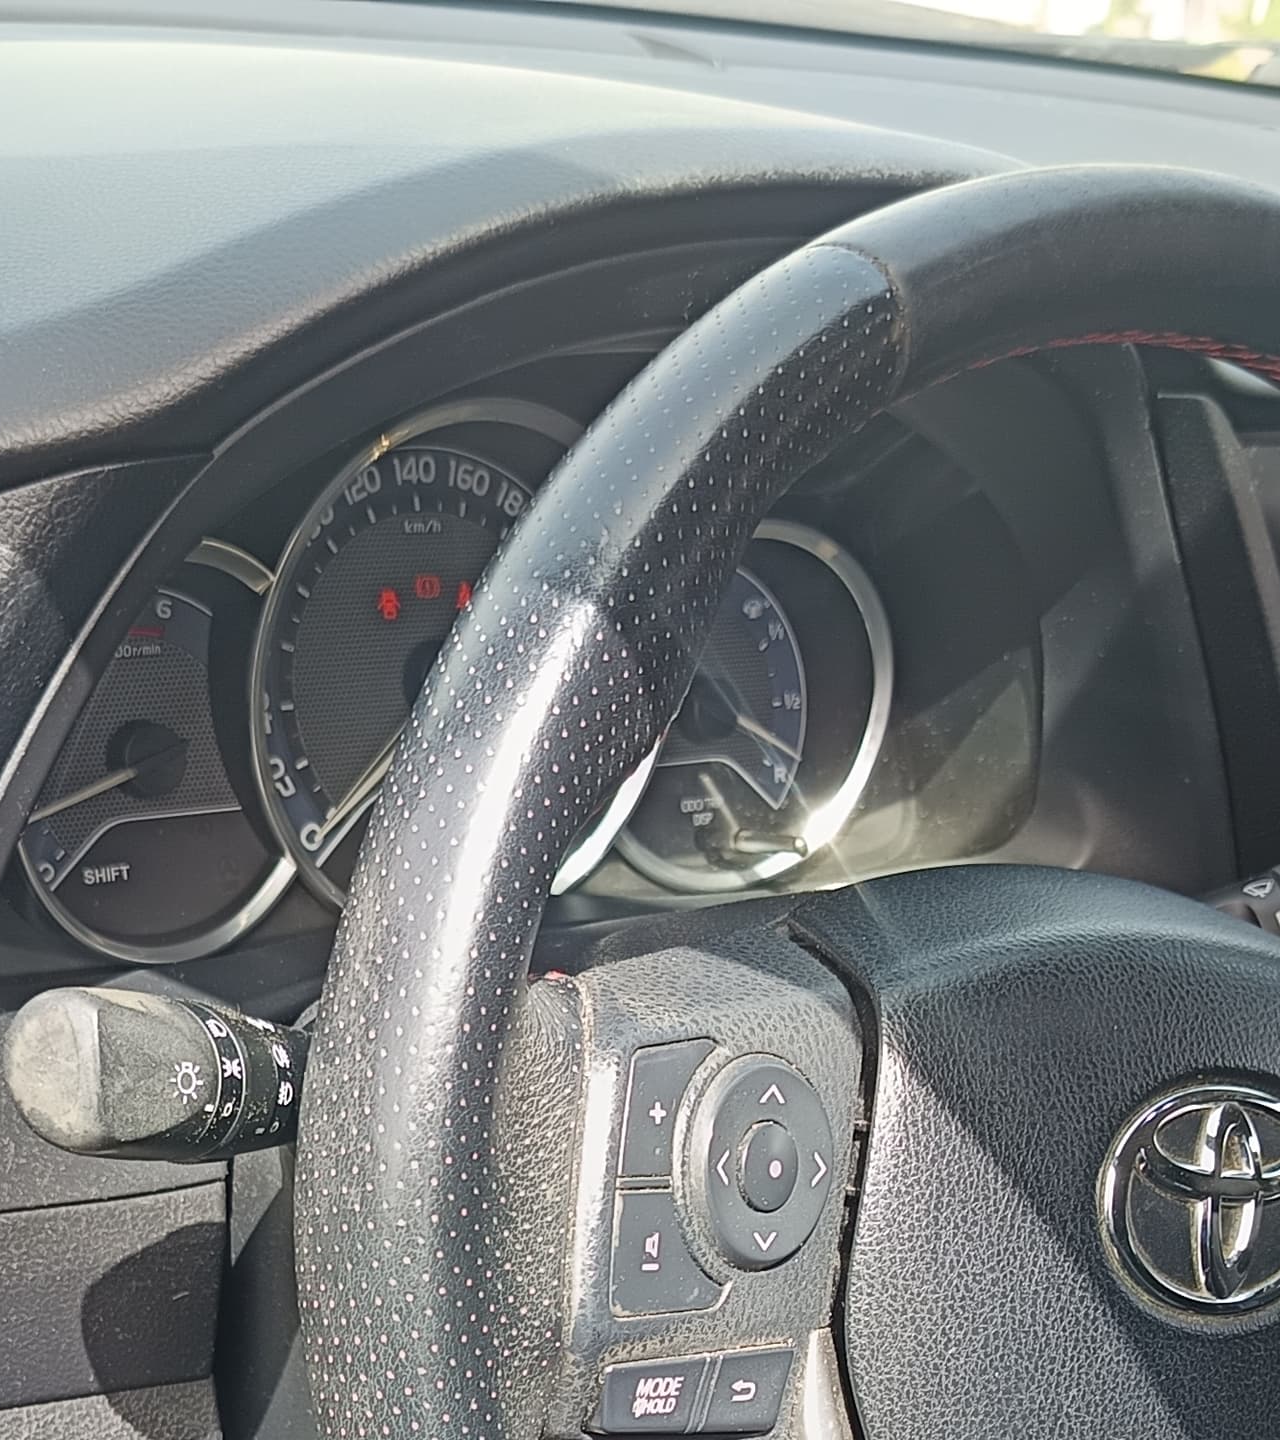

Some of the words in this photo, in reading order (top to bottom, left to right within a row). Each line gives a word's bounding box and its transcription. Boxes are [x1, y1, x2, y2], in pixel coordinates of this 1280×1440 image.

[393, 456, 437, 486] 140
[449, 460, 490, 497] 160
[344, 466, 381, 506] 120
[495, 480, 529, 517] 18
[404, 519, 442, 534] km/h
[155, 600, 172, 619] 6
[83, 865, 130, 885] SHIFT
[635, 1376, 685, 1397] MODE
